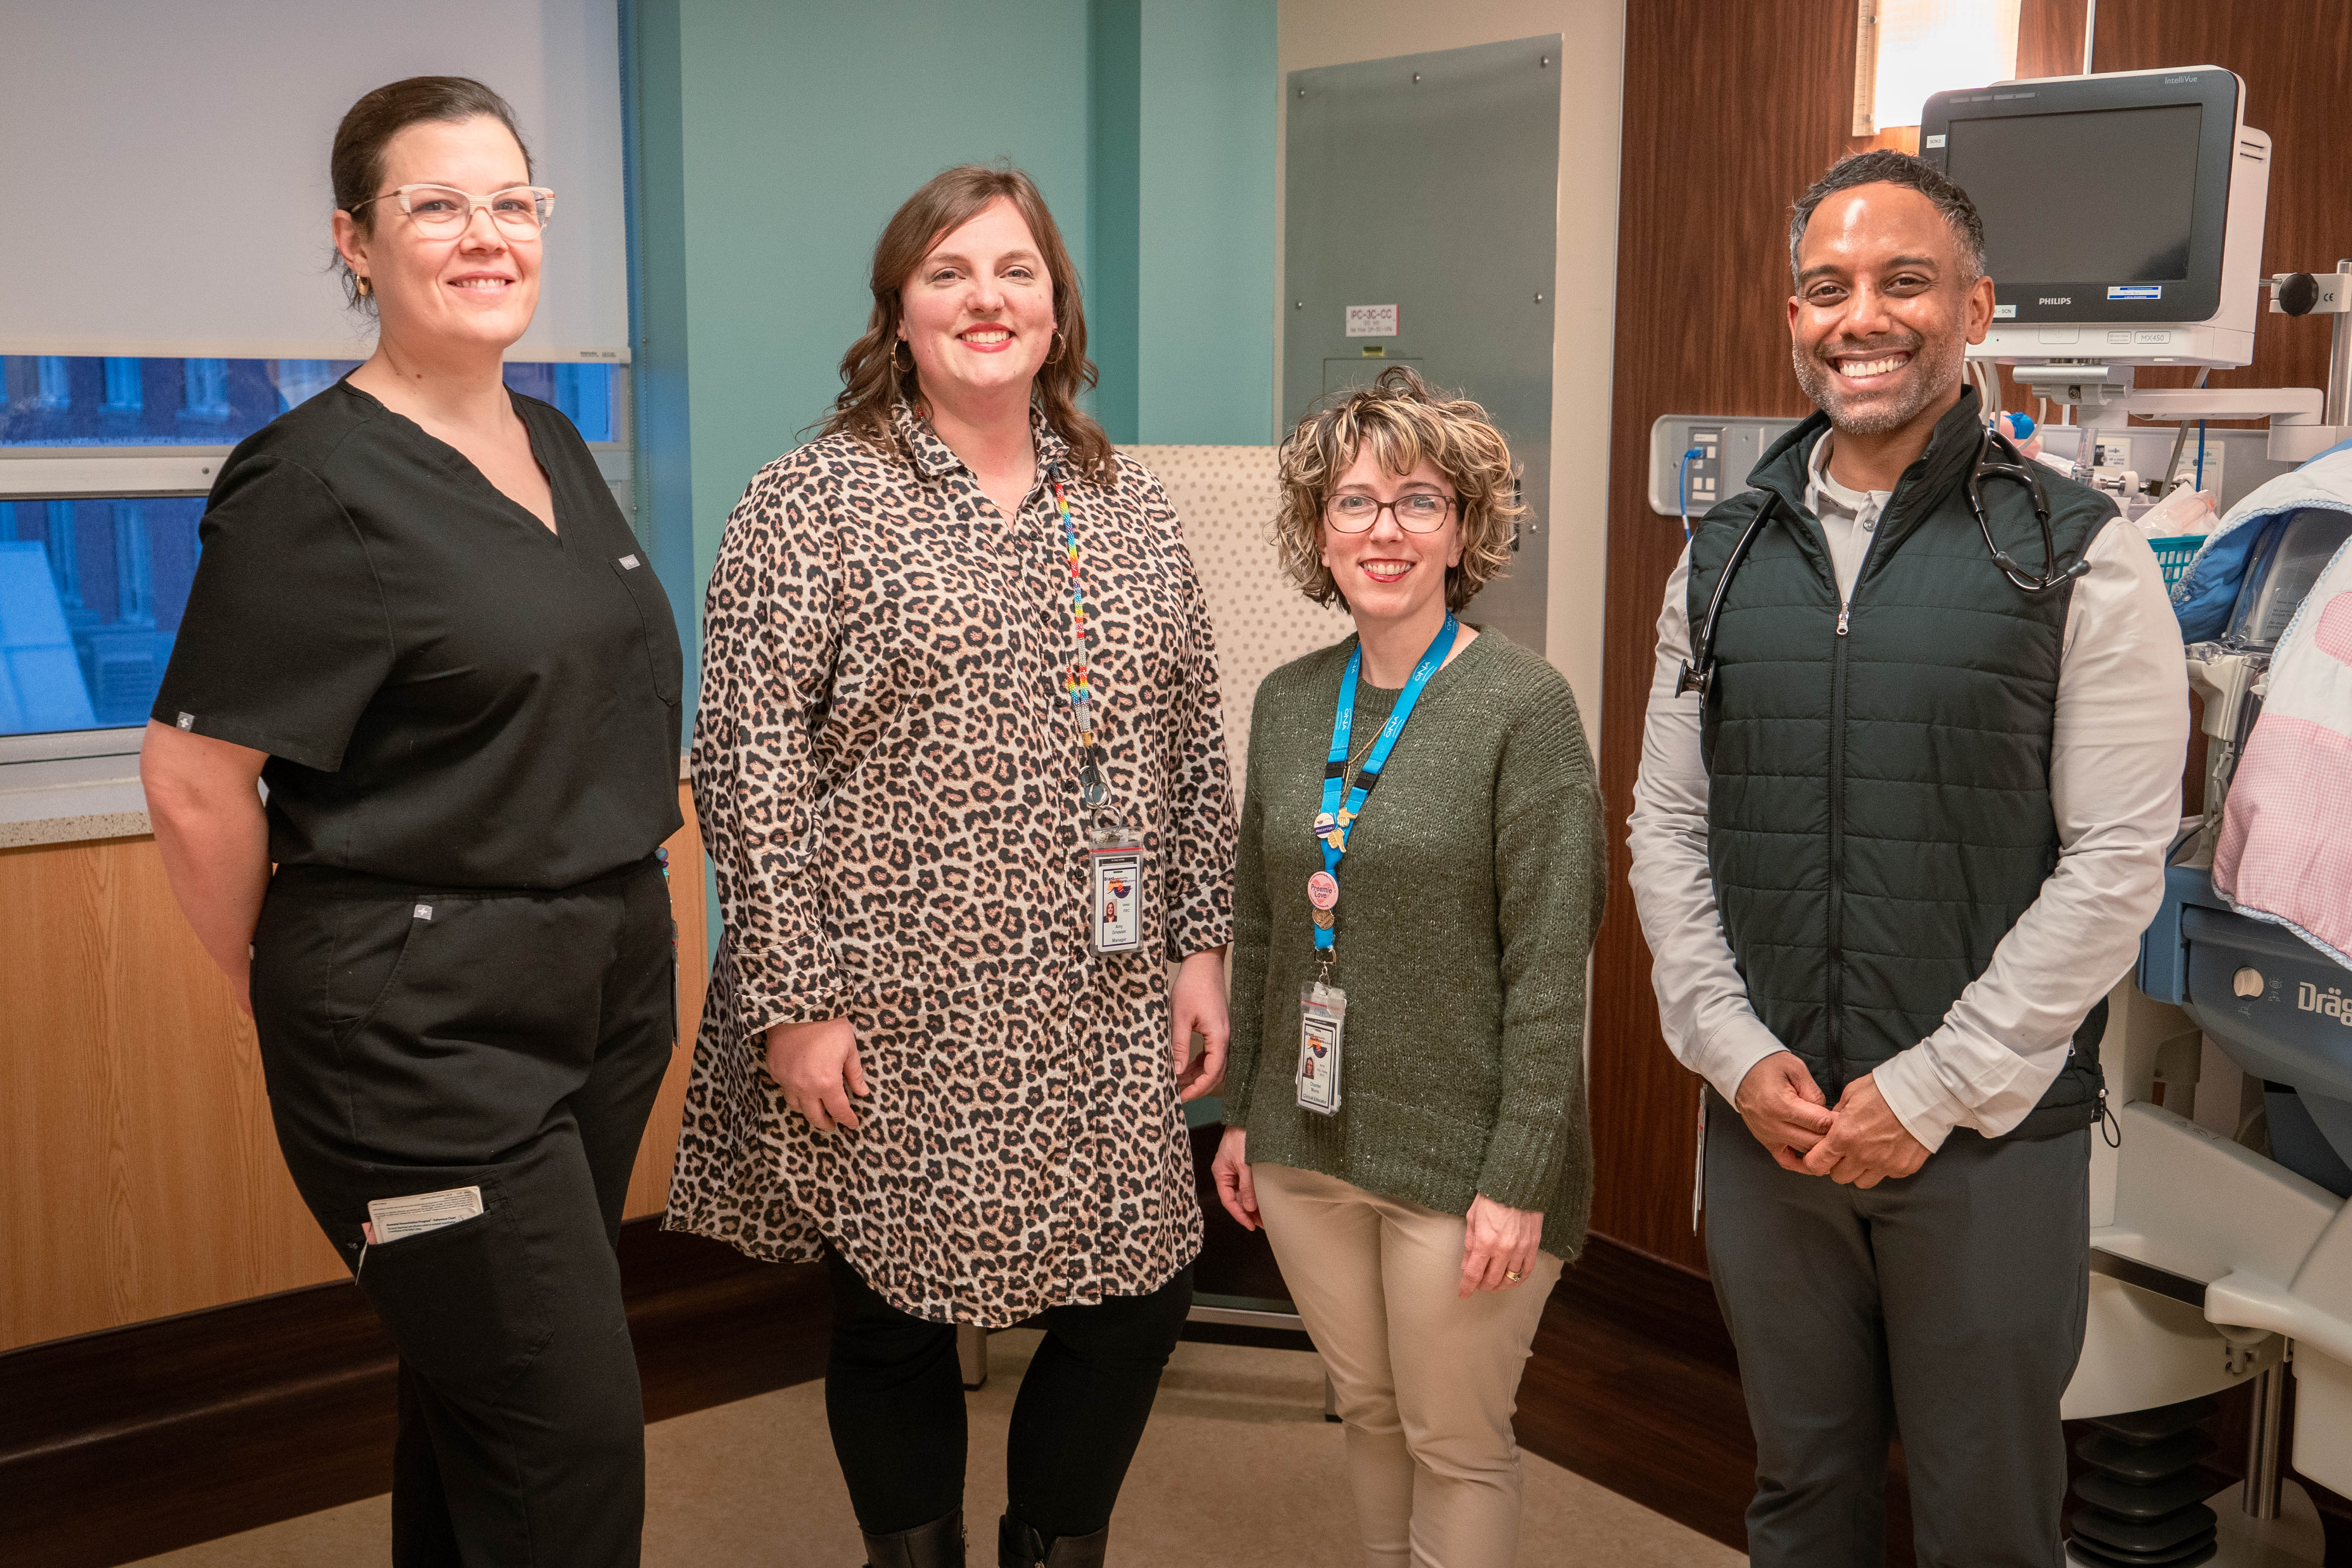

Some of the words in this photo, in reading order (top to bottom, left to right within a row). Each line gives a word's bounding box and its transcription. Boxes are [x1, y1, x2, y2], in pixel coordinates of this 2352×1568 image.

[2165, 75, 2198, 84] IntelliVue
[2324, 293, 2334, 302] CE
[1414, 662, 1431, 681] ONA
[1385, 716, 1399, 737] ONA
[1310, 883, 1332, 894] Preemie
[1314, 891, 1327, 899] Love
